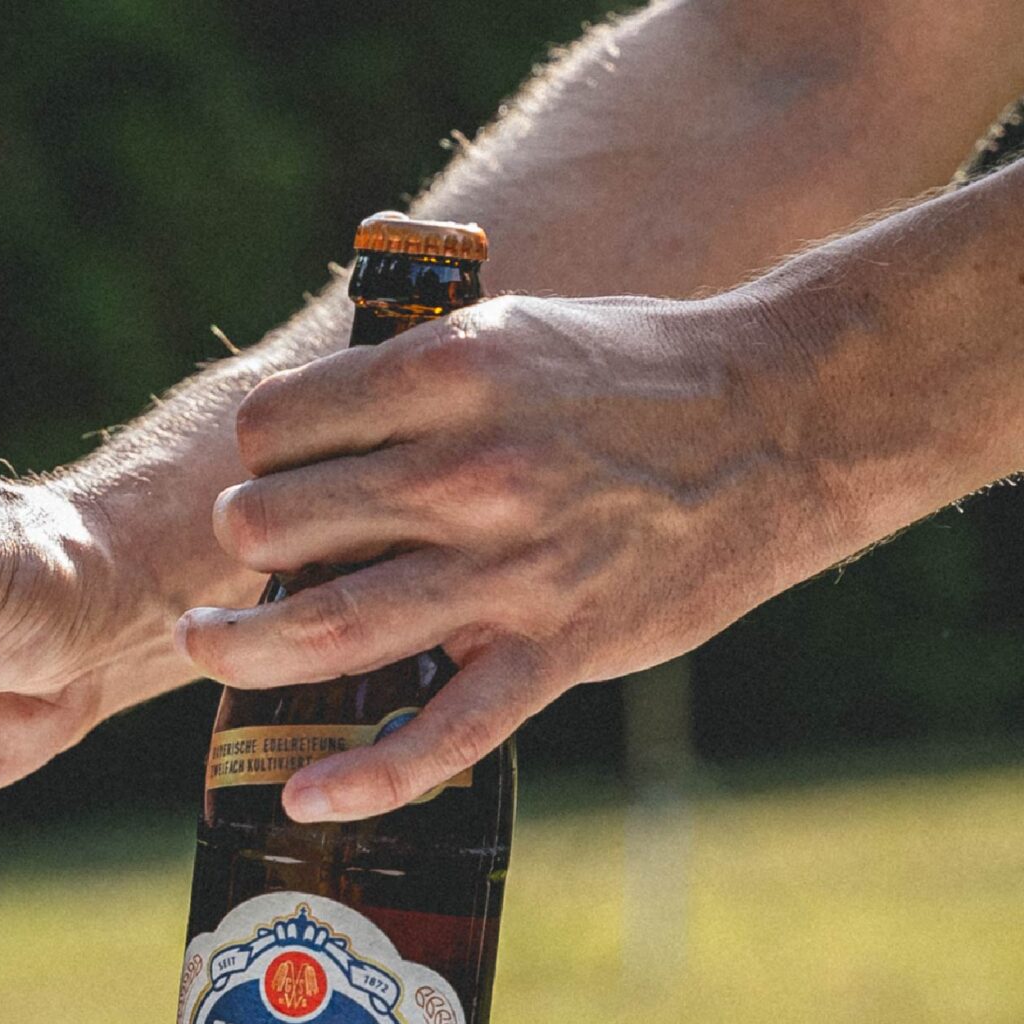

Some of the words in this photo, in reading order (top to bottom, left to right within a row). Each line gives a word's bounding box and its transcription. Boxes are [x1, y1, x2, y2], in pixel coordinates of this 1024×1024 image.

[263, 736, 346, 754] EDELREIFUNG
[218, 956, 237, 971] SEIT
[362, 975, 390, 994] 1872
